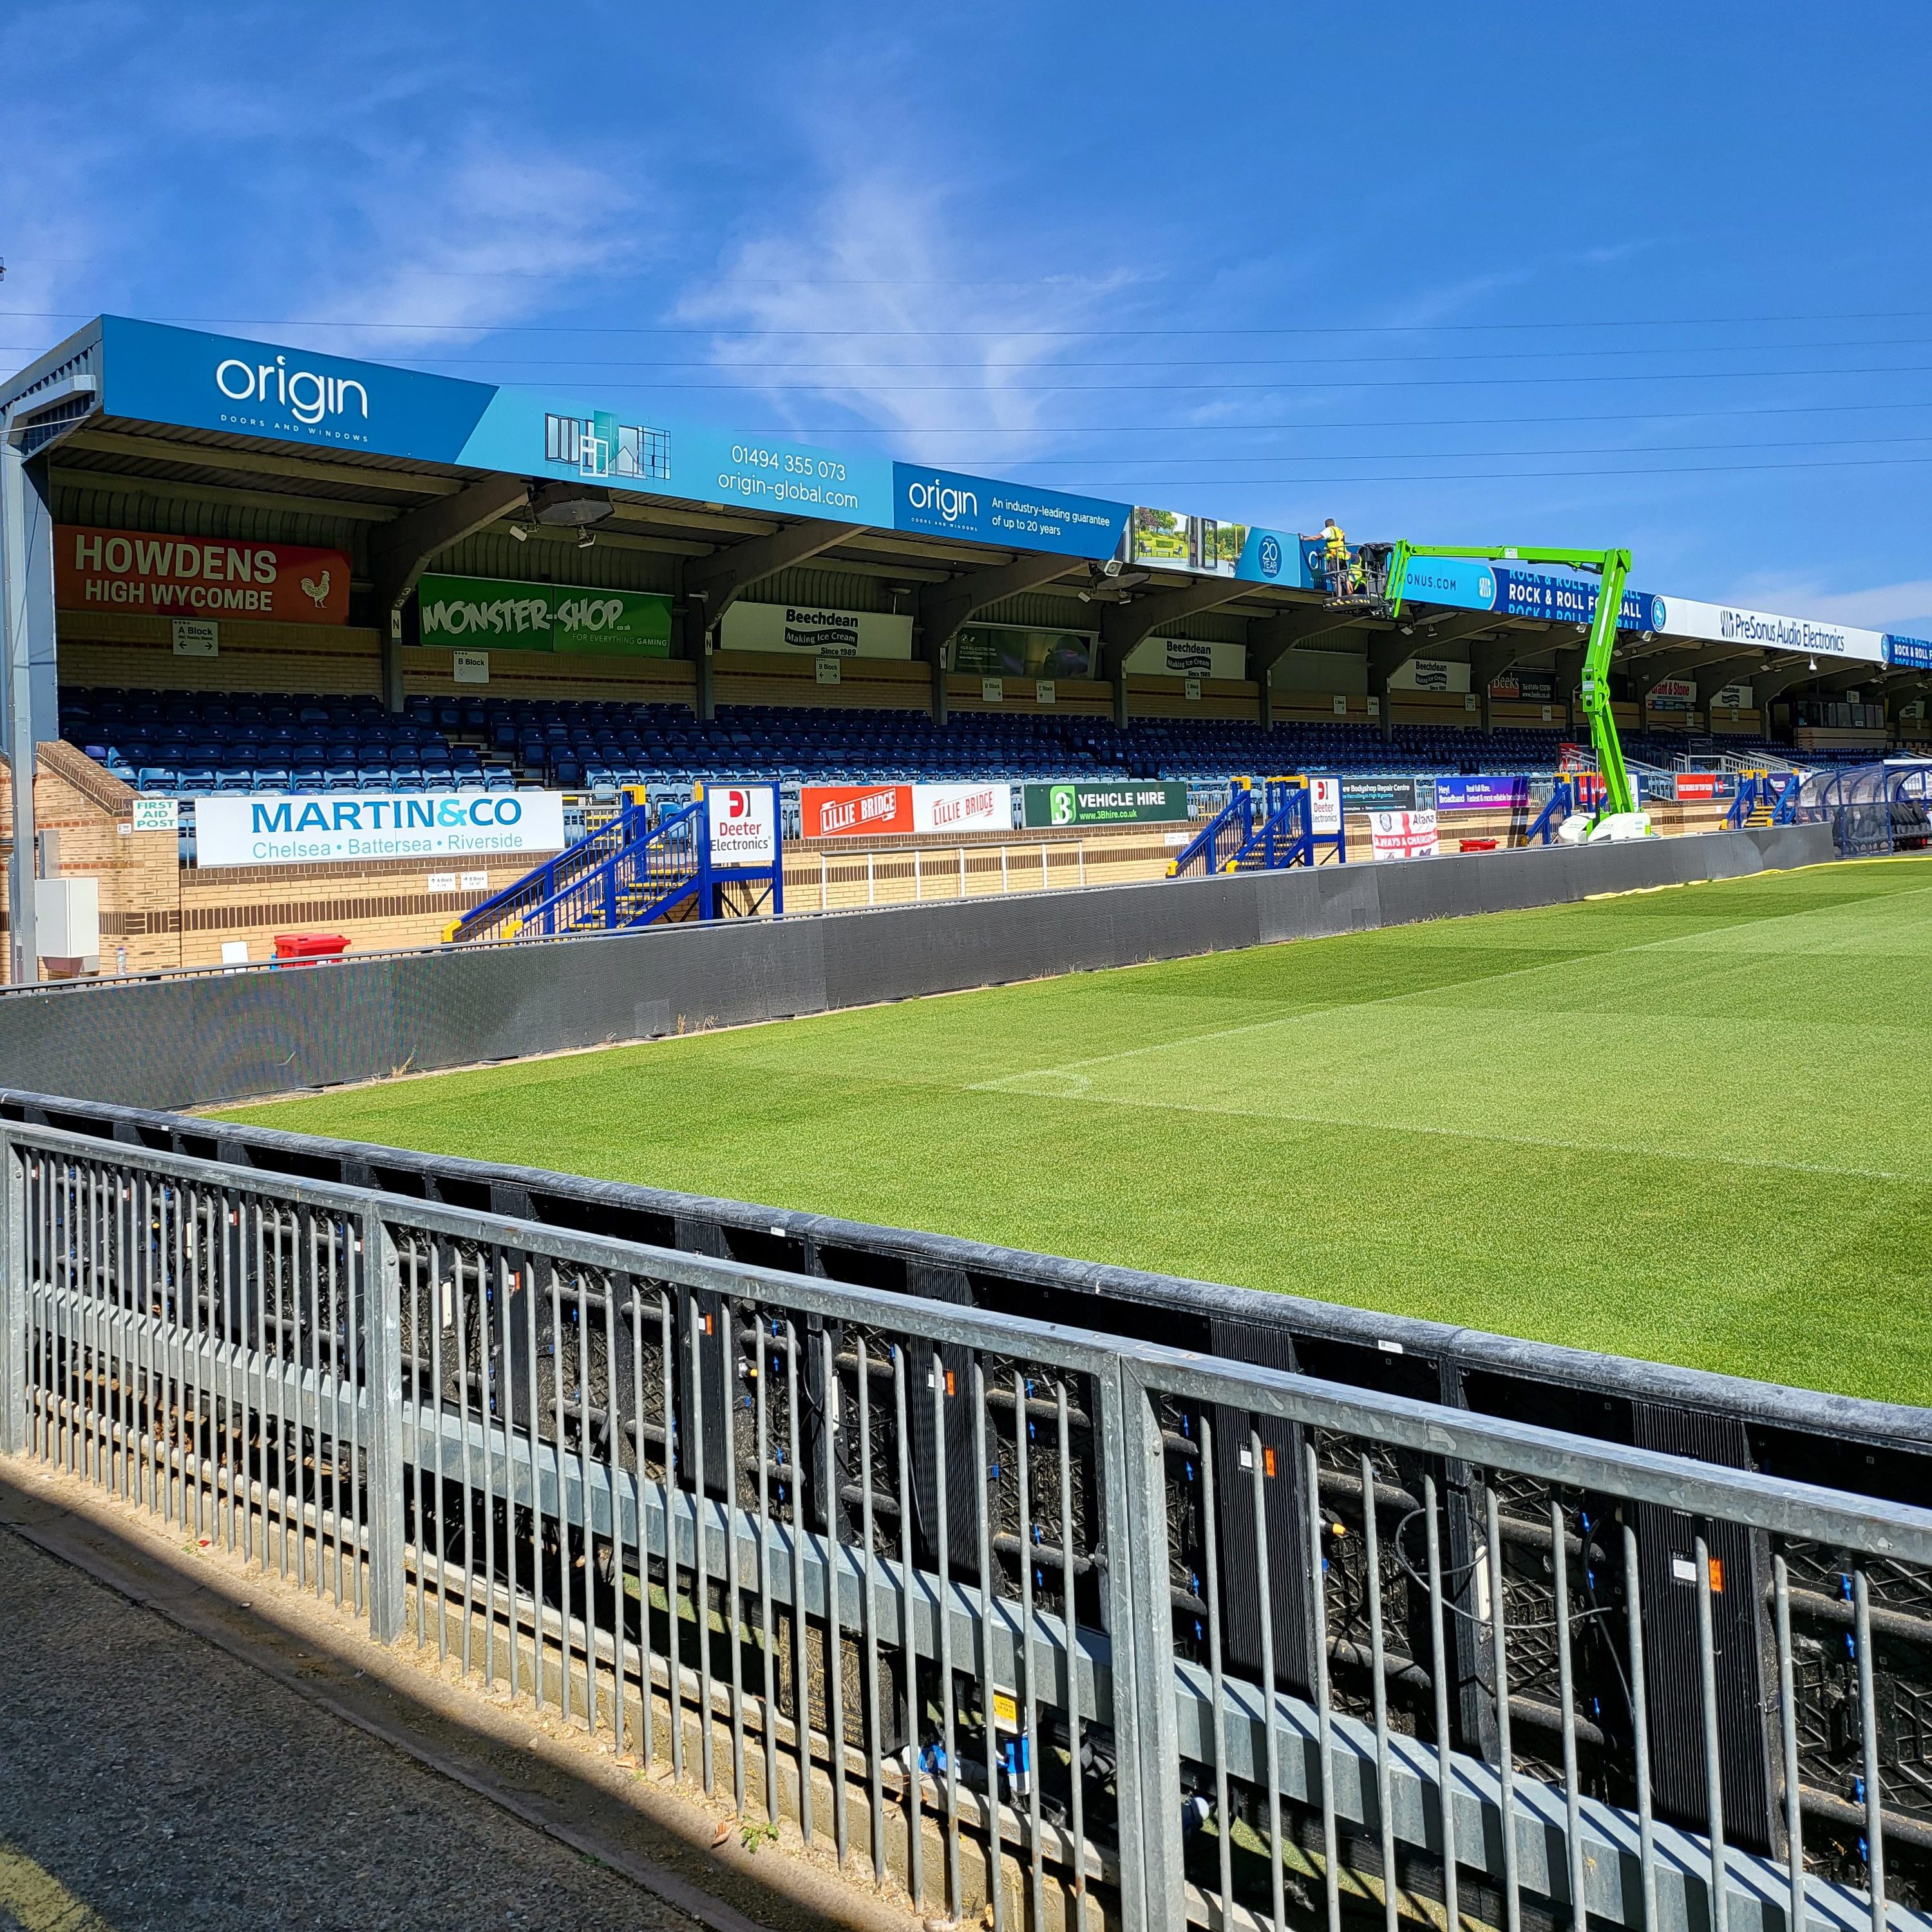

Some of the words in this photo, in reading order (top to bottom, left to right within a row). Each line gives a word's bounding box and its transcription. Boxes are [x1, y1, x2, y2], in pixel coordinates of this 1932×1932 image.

[216, 355, 368, 424] origin
[221, 414, 265, 427] DOORS
[274, 422, 299, 432] AND
[308, 428, 368, 442] WINDOWS
[732, 445, 779, 470] 01494
[784, 455, 813, 475] 355
[818, 461, 846, 481] 073
[717, 471, 858, 509] origin-global.com
[909, 478, 978, 522] origin
[992, 497, 1003, 509] An
[1005, 498, 1070, 522] industry-leading
[1072, 513, 1110, 527] guarantee
[992, 515, 1001, 526] of
[1003, 518, 1014, 530] up
[1016, 519, 1025, 530] to
[1027, 520, 1037, 532] 20
[1039, 524, 1061, 536] years
[75, 535, 277, 583] HOWDENS
[1262, 542, 1278, 561] 20
[1263, 560, 1277, 569] YEAR
[85, 579, 145, 603] HIGH
[151, 583, 273, 611] WYCOMBE
[1509, 583, 1540, 603] ROCK
[1546, 592, 1552, 605] &
[1557, 591, 1584, 610] ROLL
[393, 619, 399, 629] N
[422, 599, 623, 634] MONSTER-SHOP
[785, 609, 858, 627] Beechdean
[573, 633, 587, 642] FOR
[590, 634, 634, 645] EVERYTHING
[637, 638, 667, 647] GAMING
[786, 632, 815, 644] Making
[831, 632, 856, 643] Cream
[1735, 613, 1776, 643] PreSonus
[1776, 619, 1801, 647] Audio
[1803, 623, 1844, 653] Electronics
[706, 638, 712, 649] N
[1167, 641, 1211, 654] Beechdean
[820, 647, 839, 656] Since
[1894, 644, 1909, 657] ROCK
[1915, 647, 1928, 659] ROLL
[1168, 659, 1184, 668] Making
[1194, 658, 1209, 667] Cream
[1416, 661, 1447, 672] Beechdean
[1493, 672, 1519, 690] Beeks
[1669, 682, 1672, 695] &
[1674, 683, 1690, 696] Stone
[1350, 784, 1377, 794] Bodyshop
[1377, 784, 1393, 793] Repair
[137, 801, 174, 810] FIRST
[1078, 792, 1134, 808] VEHICLE
[1137, 791, 1166, 806] HIRE
[1439, 794, 1465, 804] Broadband
[142, 810, 168, 819] AID
[822, 802, 855, 831] LILLIE
[860, 791, 895, 820] BRIDGE
[933, 801, 960, 826] LILLIE
[965, 791, 994, 815] BRIDGE
[1079, 809, 1137, 820] www.3Bhire.co.uk
[1314, 802, 1334, 812] Deeter
[137, 819, 175, 828] POST
[252, 799, 522, 833] MARTIN&CO
[1312, 813, 1338, 822] lectronics
[1413, 814, 1434, 826] Alana
[719, 822, 762, 837] Deeter
[253, 841, 330, 858] Chelsea
[348, 838, 432, 855] Battersea
[448, 833, 522, 850] Riverside
[1401, 837, 1407, 846] A
